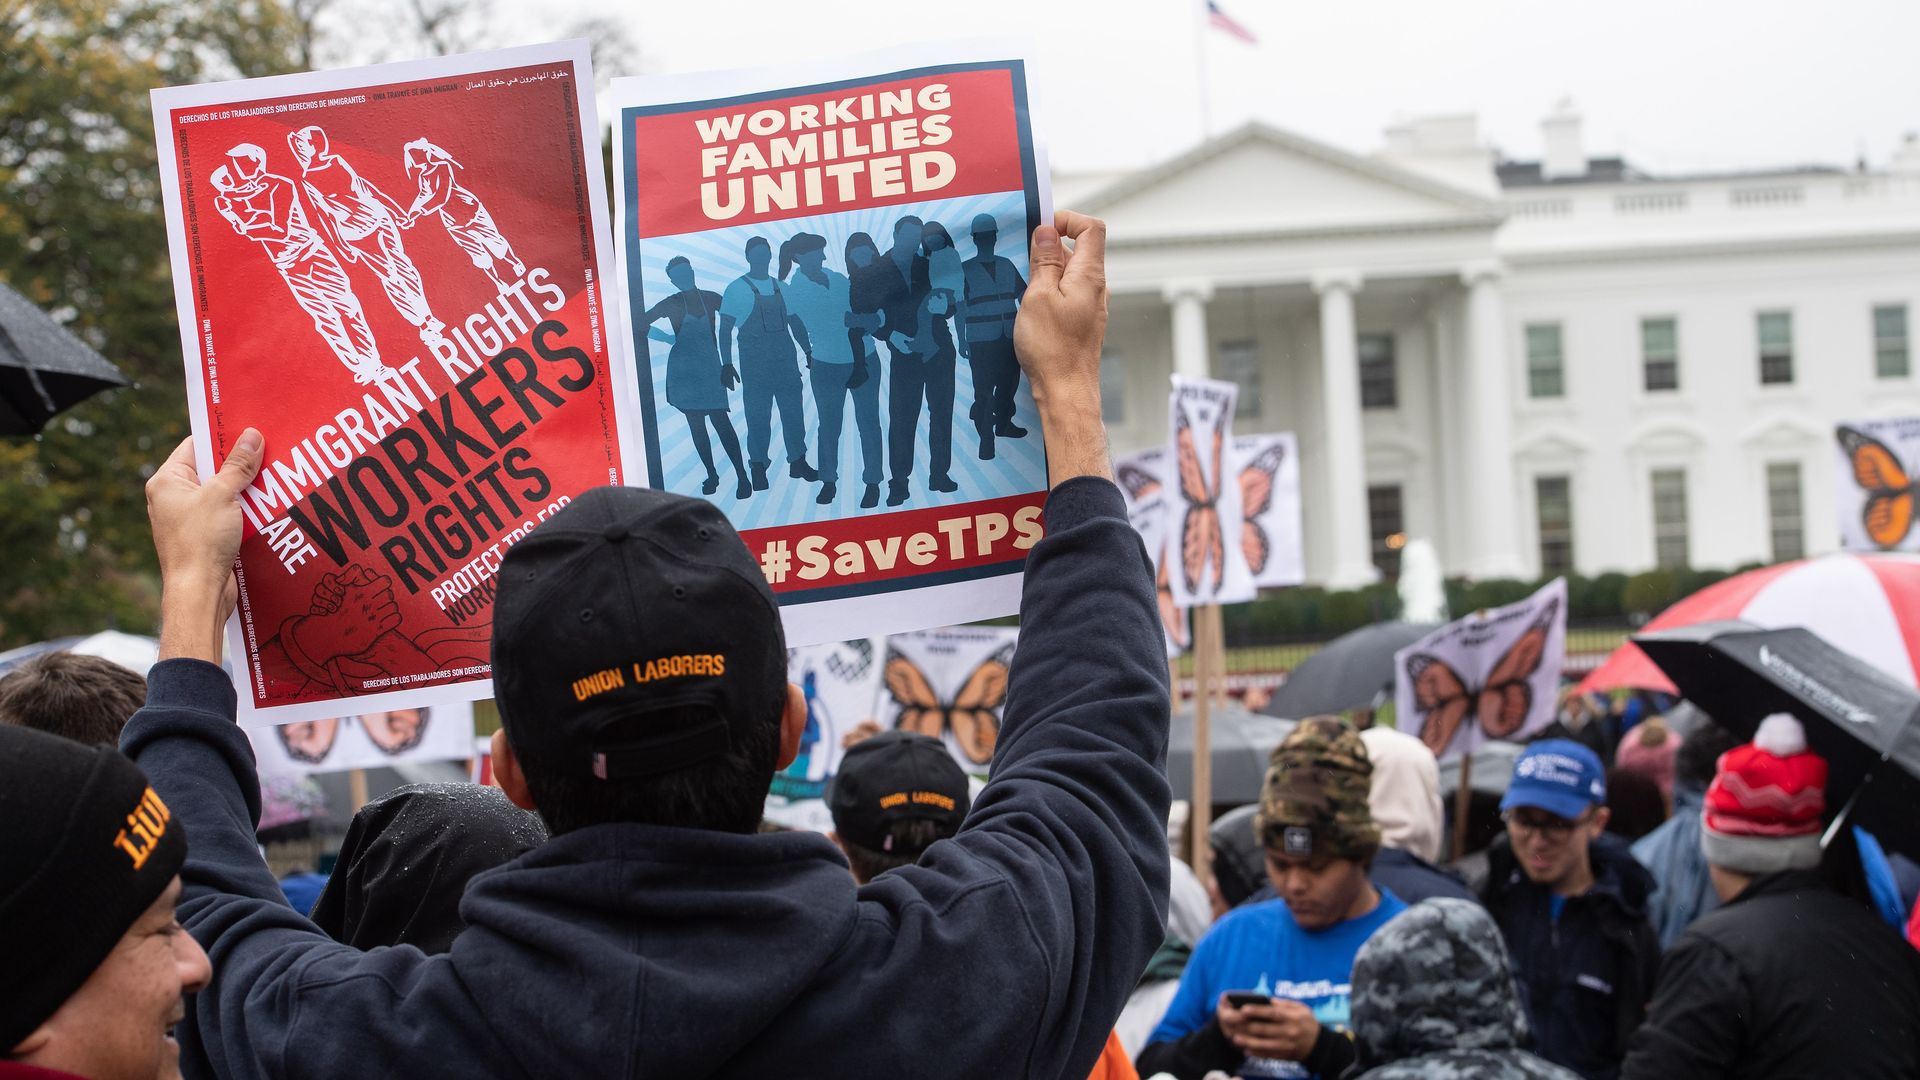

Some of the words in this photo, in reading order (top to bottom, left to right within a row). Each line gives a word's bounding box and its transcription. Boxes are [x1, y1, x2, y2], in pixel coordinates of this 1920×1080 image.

[179, 113, 209, 124] DERECHOS
[210, 112, 219, 121] DE
[219, 111, 231, 120] LOS
[231, 106, 275, 118] TRABAJADORES
[276, 104, 288, 114] SON
[289, 101, 318, 112] DERECHOS
[319, 99, 327, 108] DE
[327, 95, 366, 107] INMIGRANTES
[695, 83, 951, 144] WORKING
[701, 114, 953, 178] FAMILIES
[700, 150, 957, 221] UNITED
[585, 269, 593, 282] DWA
[590, 315, 598, 328] DWA
[203, 320, 211, 332] DWA
[209, 366, 217, 379] DWA
[240, 357, 437, 531] IMMIGRANT
[429, 267, 566, 385] RIGHTS
[287, 319, 595, 568] WORKERS
[260, 516, 318, 575] ARE
[379, 446, 552, 596] RIGHTS
[761, 505, 1044, 584] #SaveTPS
[236, 568, 250, 611] TRABAJADORES
[430, 543, 504, 611] PROTECT
[245, 611, 253, 623] SON
[247, 624, 258, 653] DERECHOS
[252, 653, 260, 661] DE
[254, 661, 266, 699] INMIGRANTES
[363, 678, 391, 689] DERECHOS
[391, 676, 399, 685] DE
[399, 675, 410, 683] LOS
[410, 670, 452, 682] TRABAJADORES
[452, 668, 464, 677] SON
[572, 668, 625, 701] UNION
[633, 654, 725, 683] LABORERS
